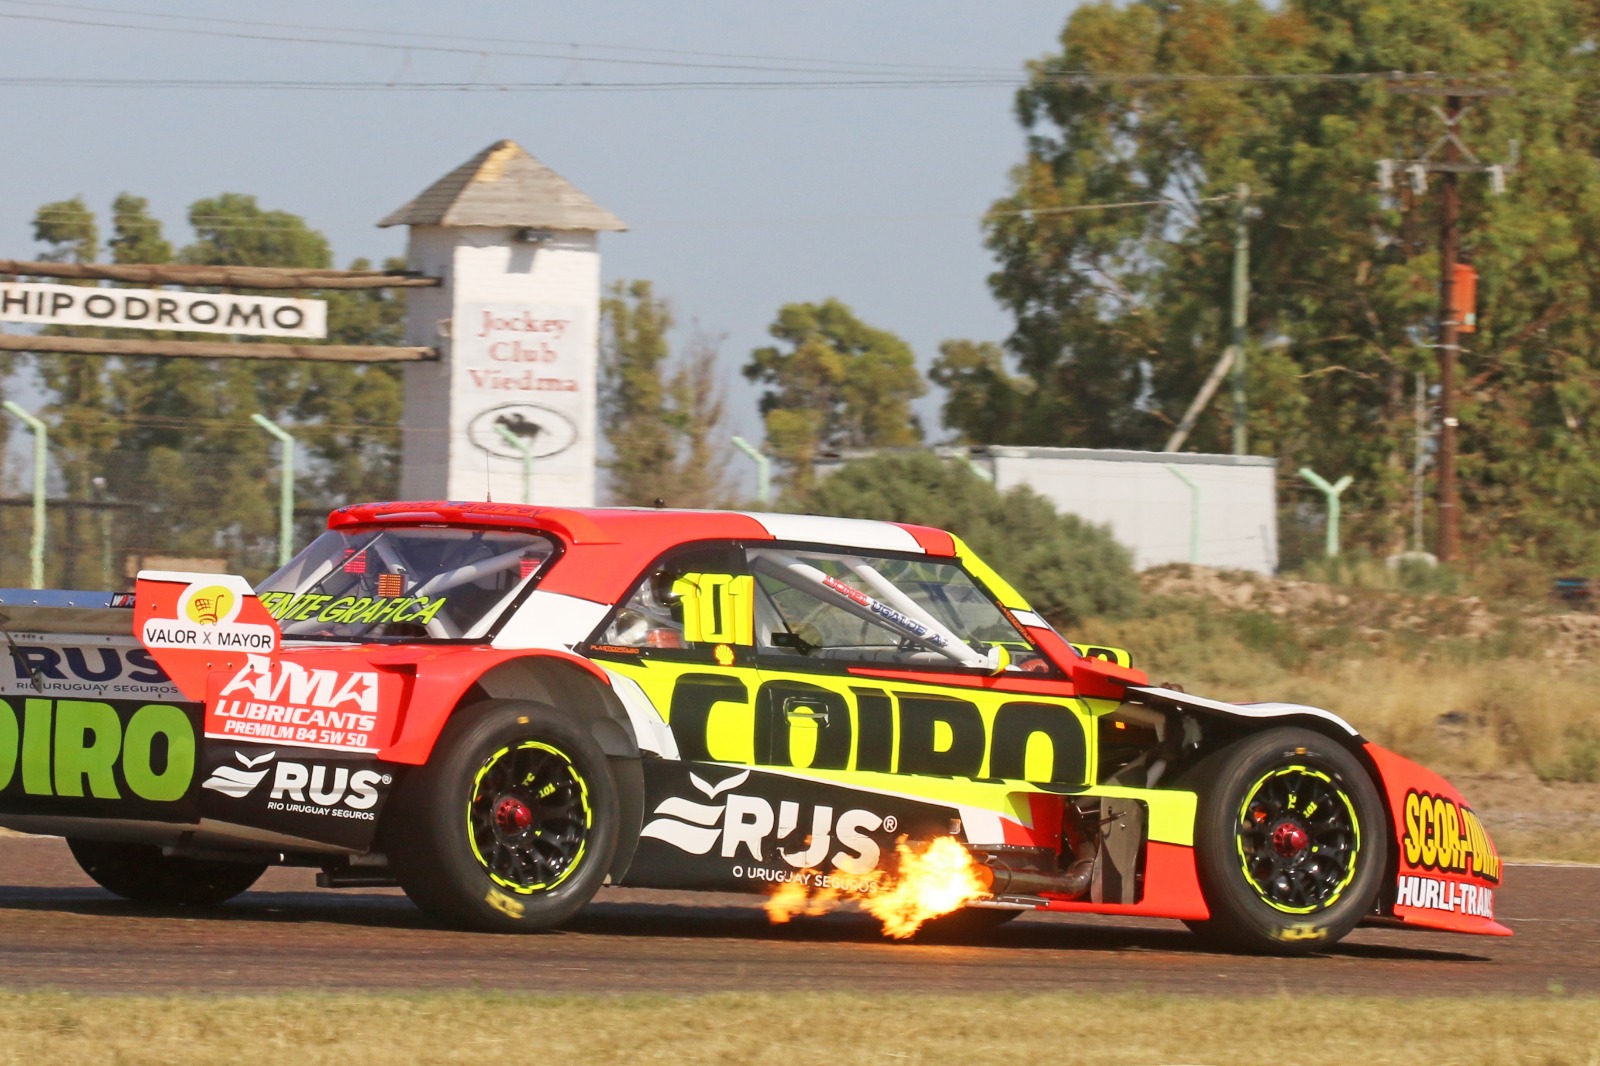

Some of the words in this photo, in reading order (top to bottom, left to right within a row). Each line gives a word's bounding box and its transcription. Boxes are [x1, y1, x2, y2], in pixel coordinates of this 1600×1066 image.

[1, 290, 304, 330] HIPODROMO
[476, 310, 570, 339] Jockey
[488, 340, 558, 364] Club
[467, 368, 578, 392] Viedma
[316, 595, 447, 625] GRAFICA
[672, 573, 754, 646] 101
[870, 600, 928, 637] UGALDE
[146, 628, 197, 644] VALOR
[202, 631, 212, 645] X
[217, 632, 272, 649] MAYOR
[9, 645, 173, 684] RUS
[43, 683, 109, 692] URUGUAY
[113, 685, 179, 694] SEGUROS
[219, 653, 379, 713] AMA
[214, 699, 377, 732] LUBRICANTS
[224, 719, 295, 740] PREMIUM
[296, 727, 317, 742] 84
[539, 782, 556, 799] 101
[267, 801, 284, 812] RIO
[286, 803, 331, 816] URUGUAY
[331, 808, 375, 821] SEGUROS
[1303, 801, 1318, 819] 101
[747, 867, 811, 886] URUGUAY
[814, 873, 878, 894] SEGUROS
